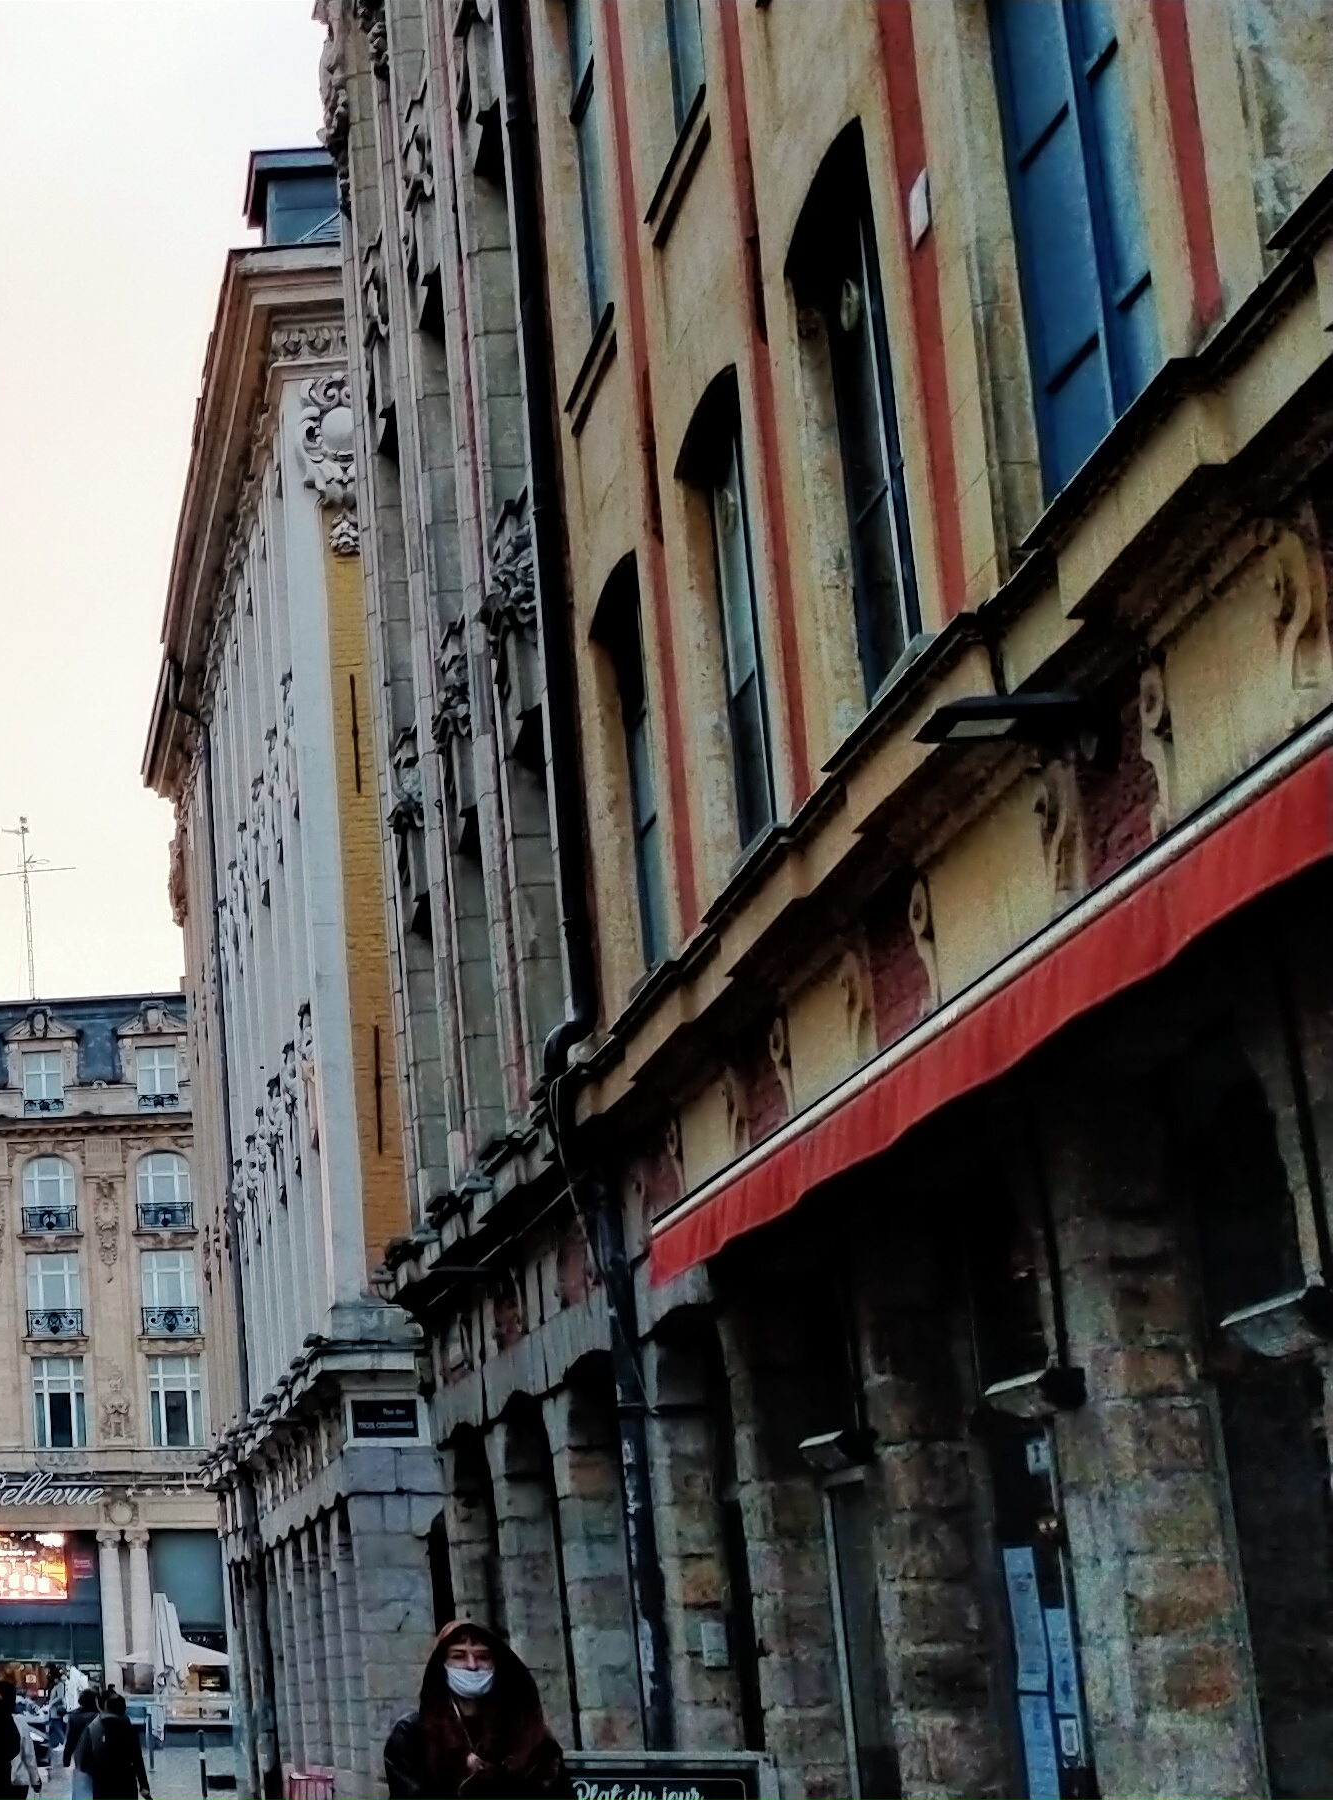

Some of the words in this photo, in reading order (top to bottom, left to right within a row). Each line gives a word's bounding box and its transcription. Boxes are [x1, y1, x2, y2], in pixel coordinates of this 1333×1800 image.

[572, 1780, 624, 1800] Plat
[627, 1784, 657, 1800] du
[661, 1786, 705, 1800] jour
